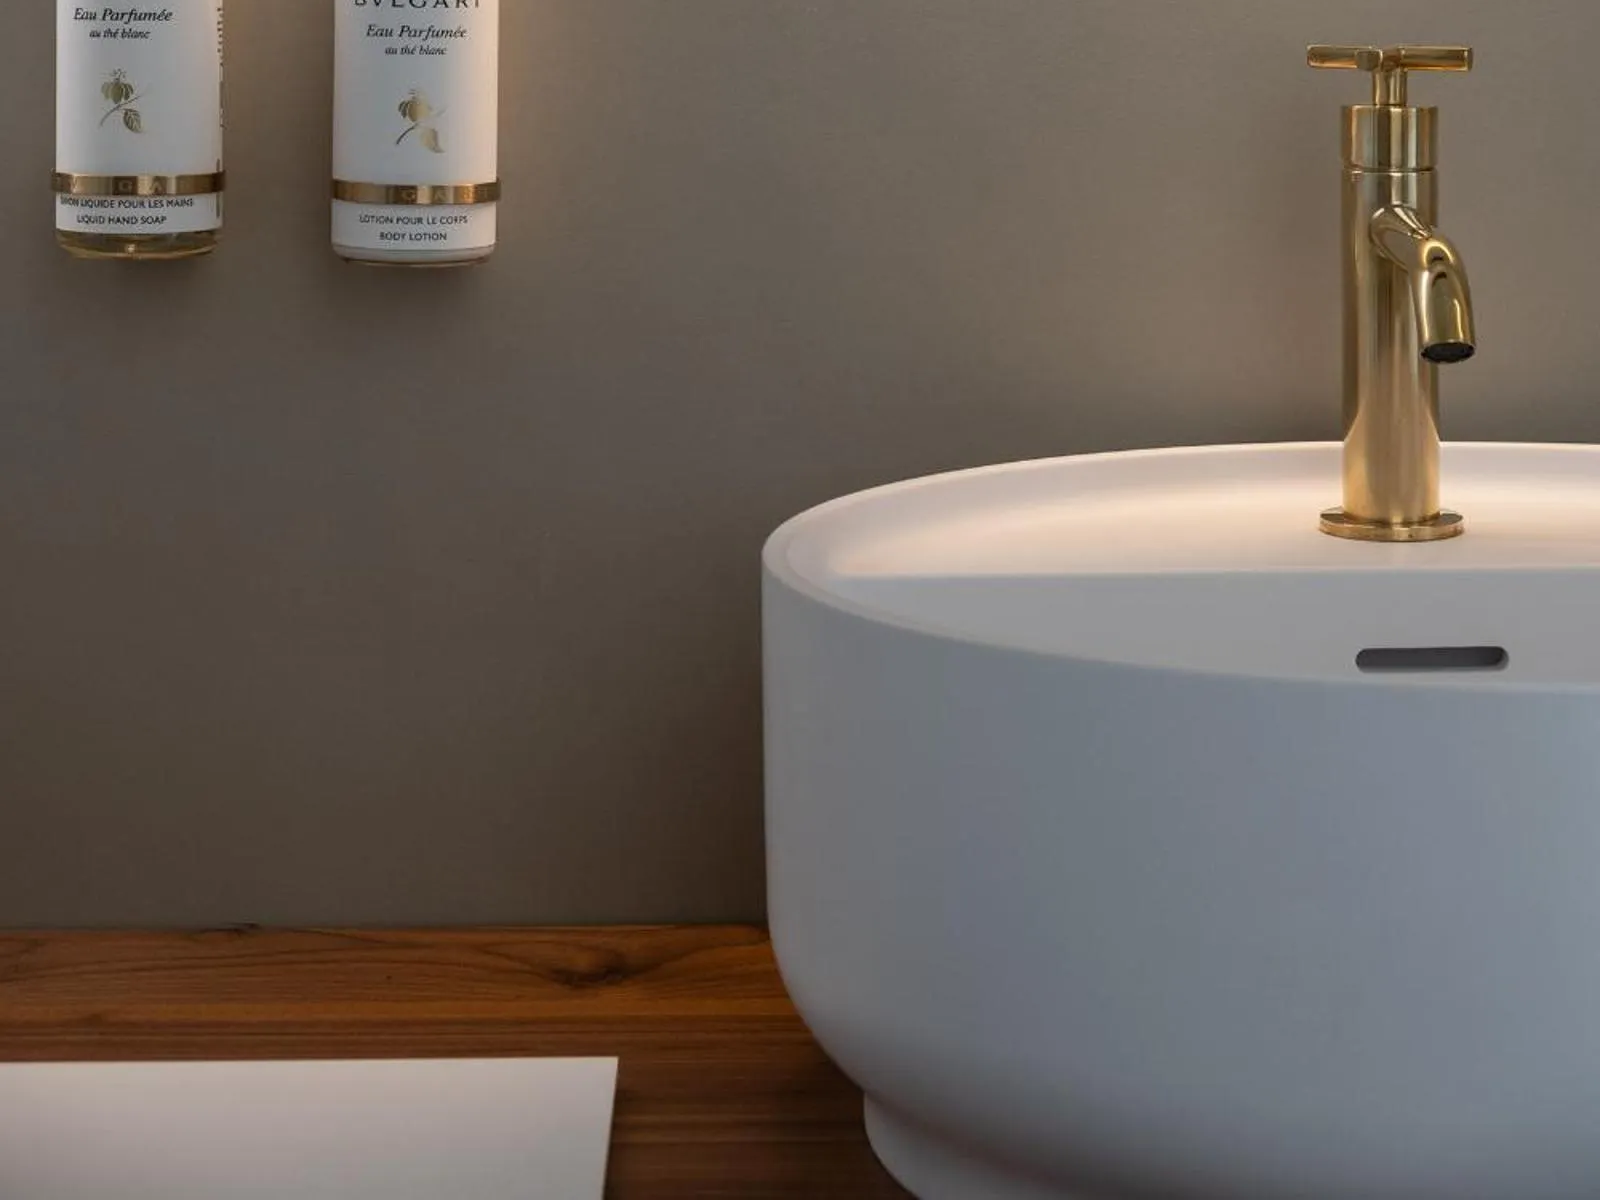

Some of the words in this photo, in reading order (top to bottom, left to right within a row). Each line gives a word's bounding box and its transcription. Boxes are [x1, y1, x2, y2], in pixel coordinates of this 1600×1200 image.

[73, 7, 97, 21] Eau
[101, 6, 173, 25] Parfumée
[89, 30, 101, 39] au
[103, 28, 119, 39] thé
[121, 28, 151, 39] blanc
[366, 23, 393, 37] Eau
[398, 24, 468, 41] Parfumée
[384, 46, 397, 55] au
[400, 45, 416, 55] thé
[418, 45, 447, 55] blanc
[80, 198, 115, 210] LIQUIDE
[117, 199, 145, 209] POUR
[148, 199, 164, 209] LES
[166, 198, 194, 208] MAINS
[76, 214, 105, 225] LIQUID
[108, 216, 138, 225] HAND
[140, 215, 167, 225] SOAP
[359, 214, 394, 225] LOTION
[396, 215, 423, 225] POUR
[426, 216, 437, 225] LE
[440, 215, 468, 225] CORPS
[379, 231, 407, 241] BODY
[409, 231, 447, 241] LOTION
